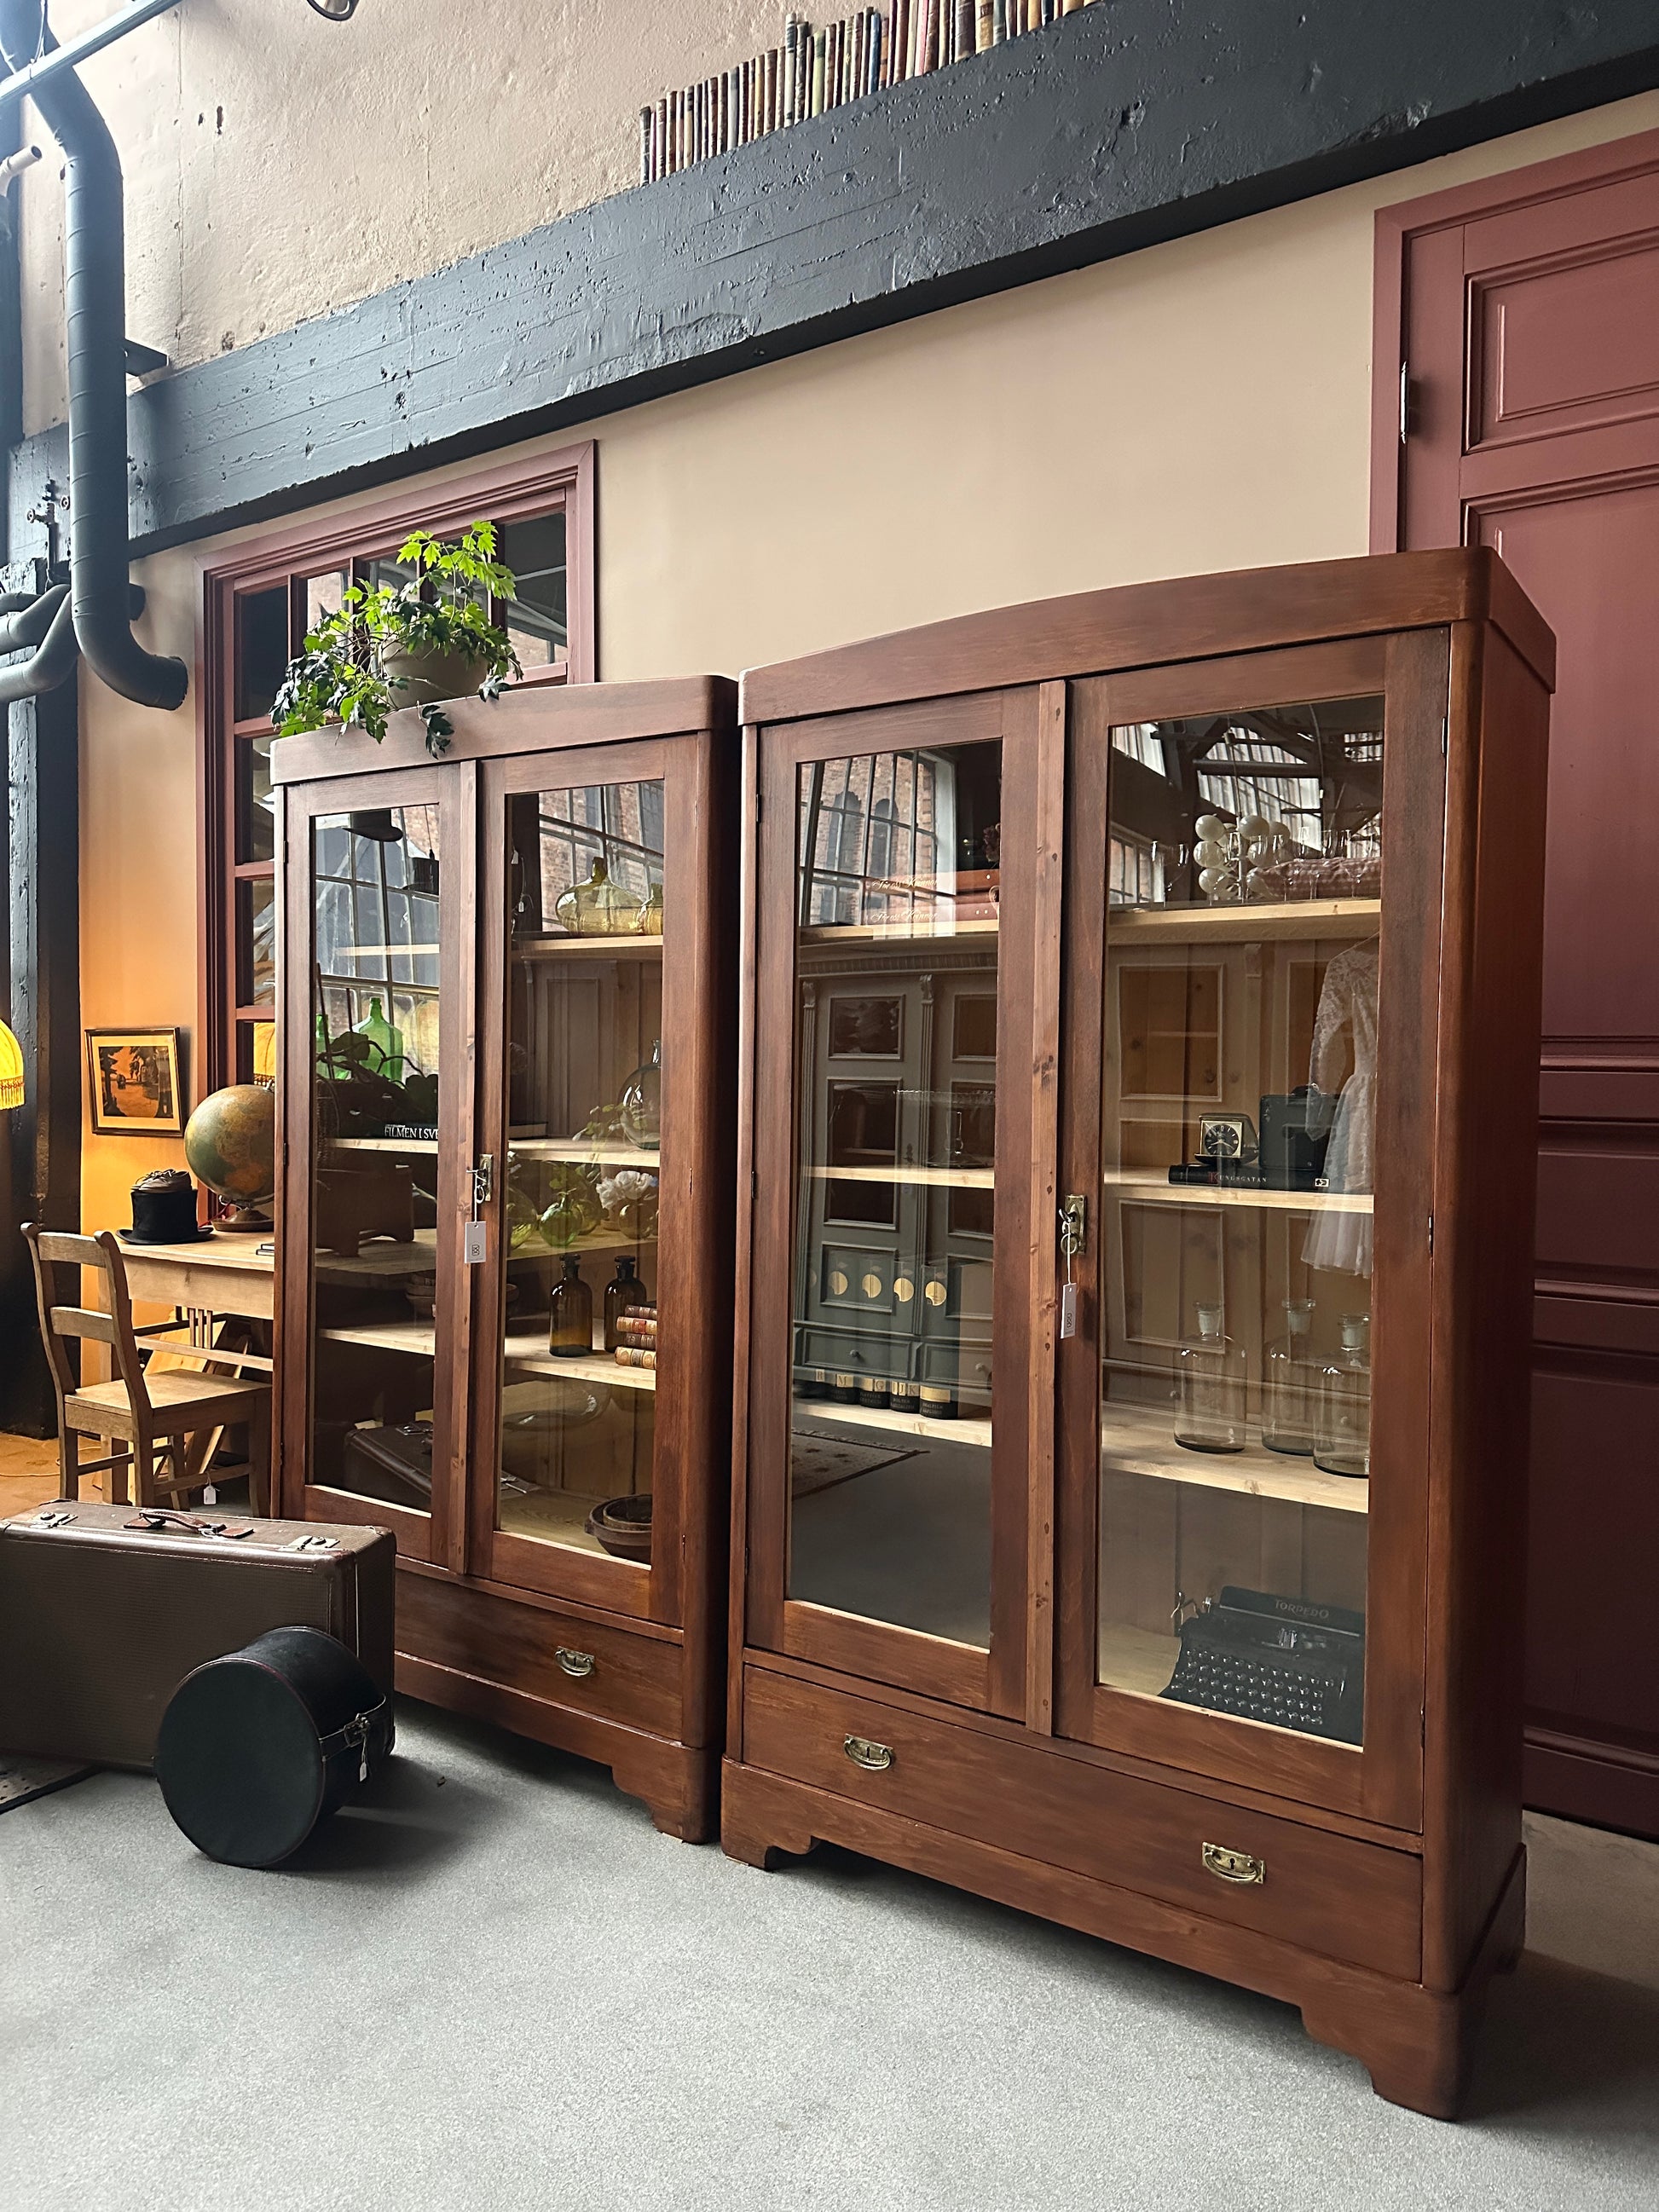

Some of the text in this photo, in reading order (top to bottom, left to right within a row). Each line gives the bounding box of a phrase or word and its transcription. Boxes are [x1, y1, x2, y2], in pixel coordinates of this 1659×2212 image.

[384, 1127, 417, 1138] FILMEN
[419, 1128, 423, 1138] I
[1208, 1171, 1268, 1183] KUNGSGATAN
[875, 1380, 884, 1390] G
[909, 1384, 917, 1395] K
[1275, 1600, 1329, 1619] TORPEDO
